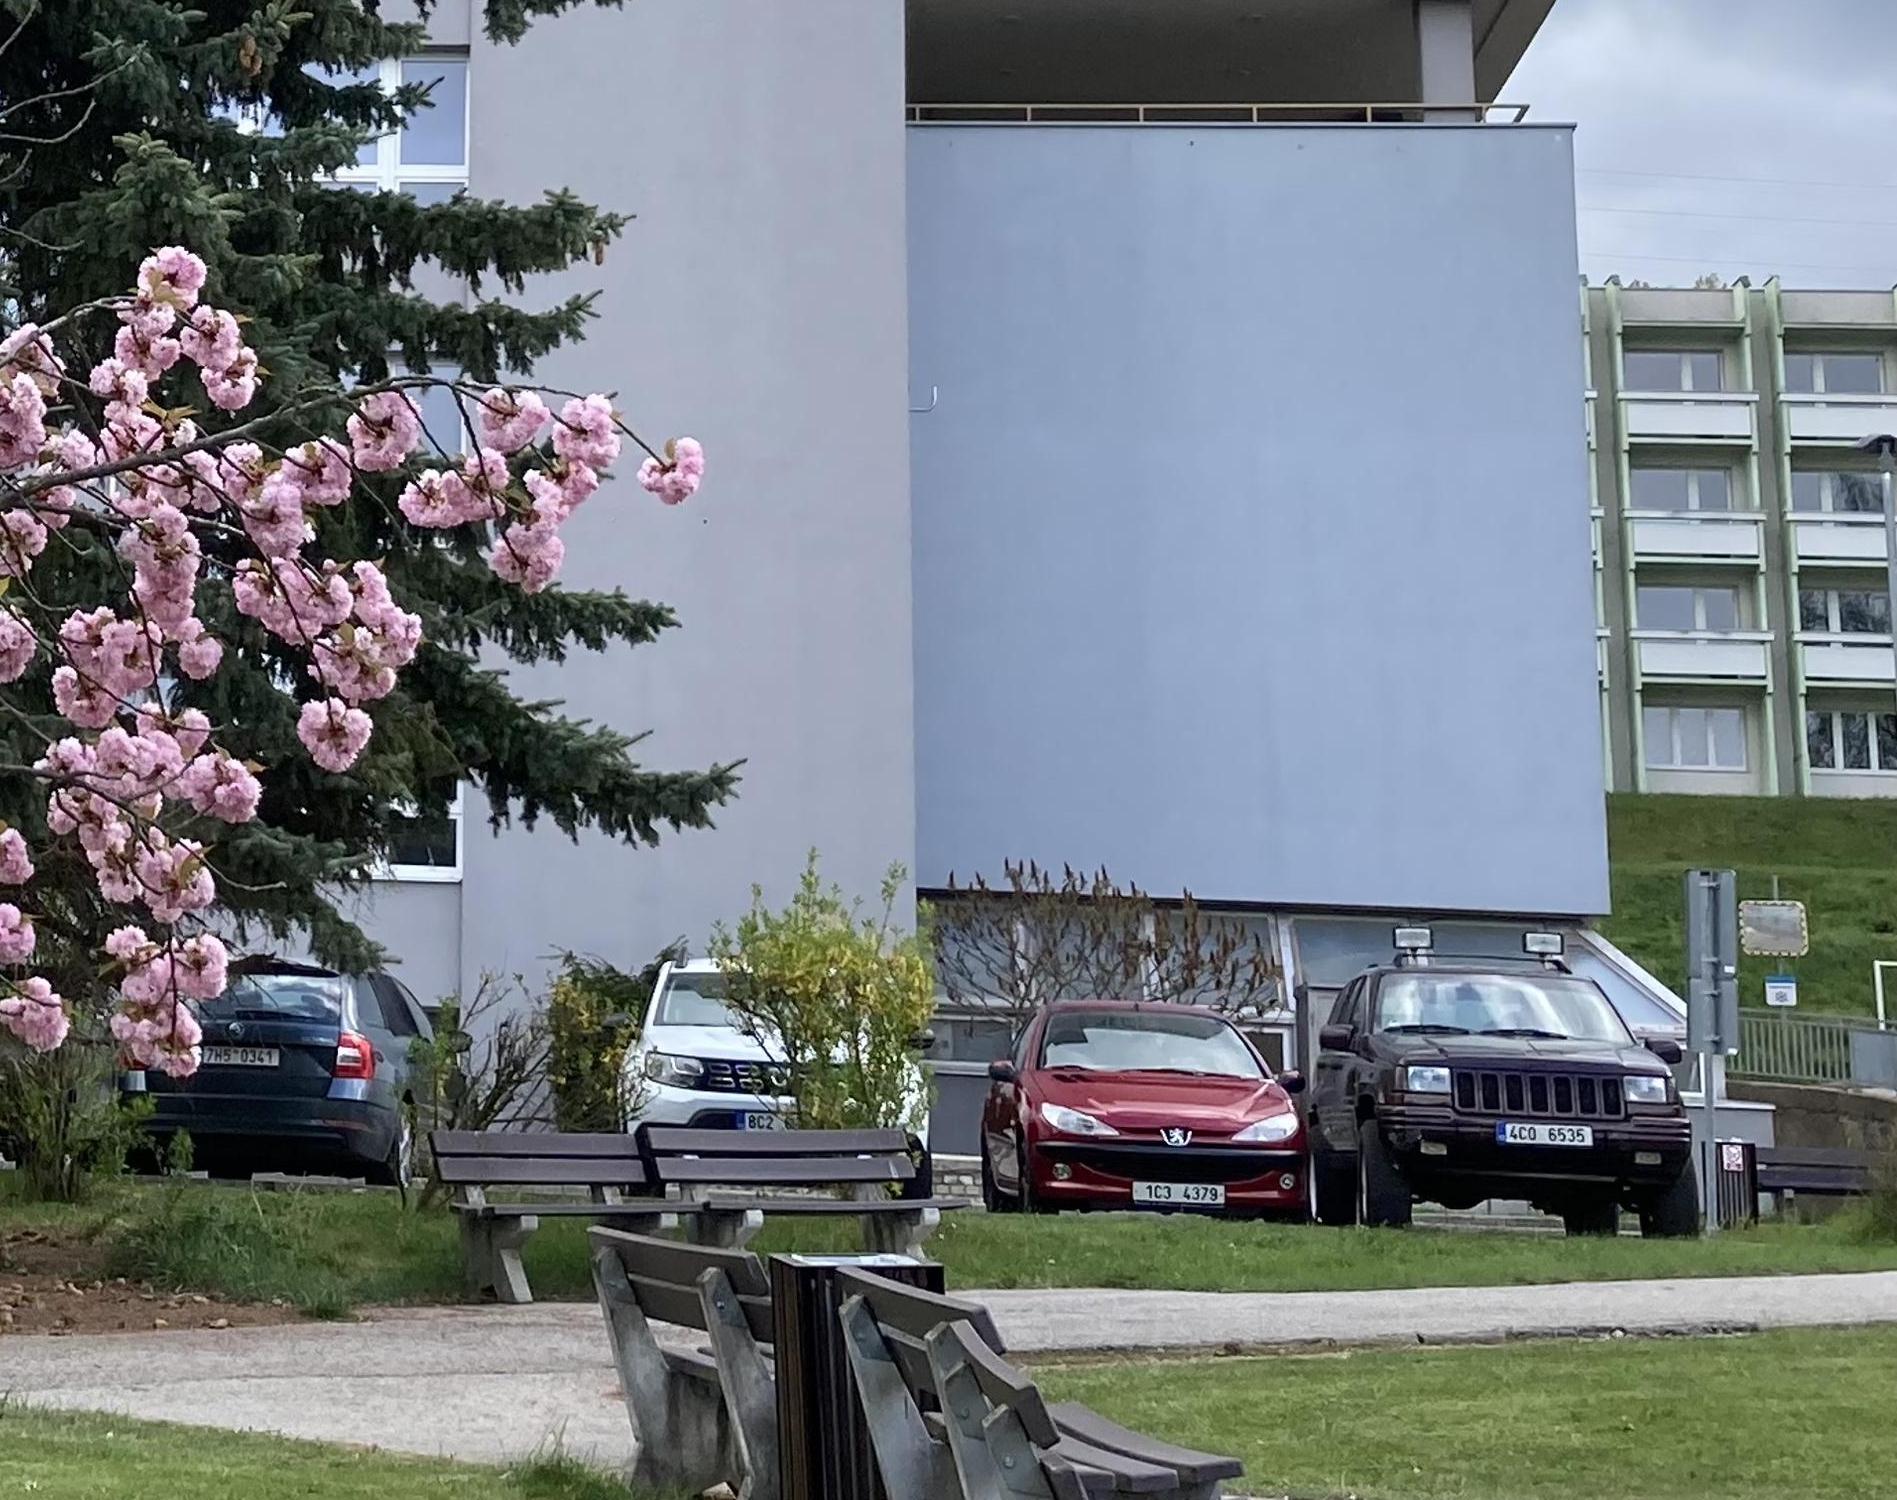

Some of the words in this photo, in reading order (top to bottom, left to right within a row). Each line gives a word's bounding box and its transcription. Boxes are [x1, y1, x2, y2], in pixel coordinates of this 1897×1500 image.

[207, 1047, 231, 1062] 7H5
[748, 1114, 774, 1130] 8C2
[1509, 1126, 1537, 1141] 4C0
[1548, 1127, 1585, 1143] 6535
[1145, 1185, 1171, 1199] 1C3
[1183, 1186, 1218, 1202] 4379
